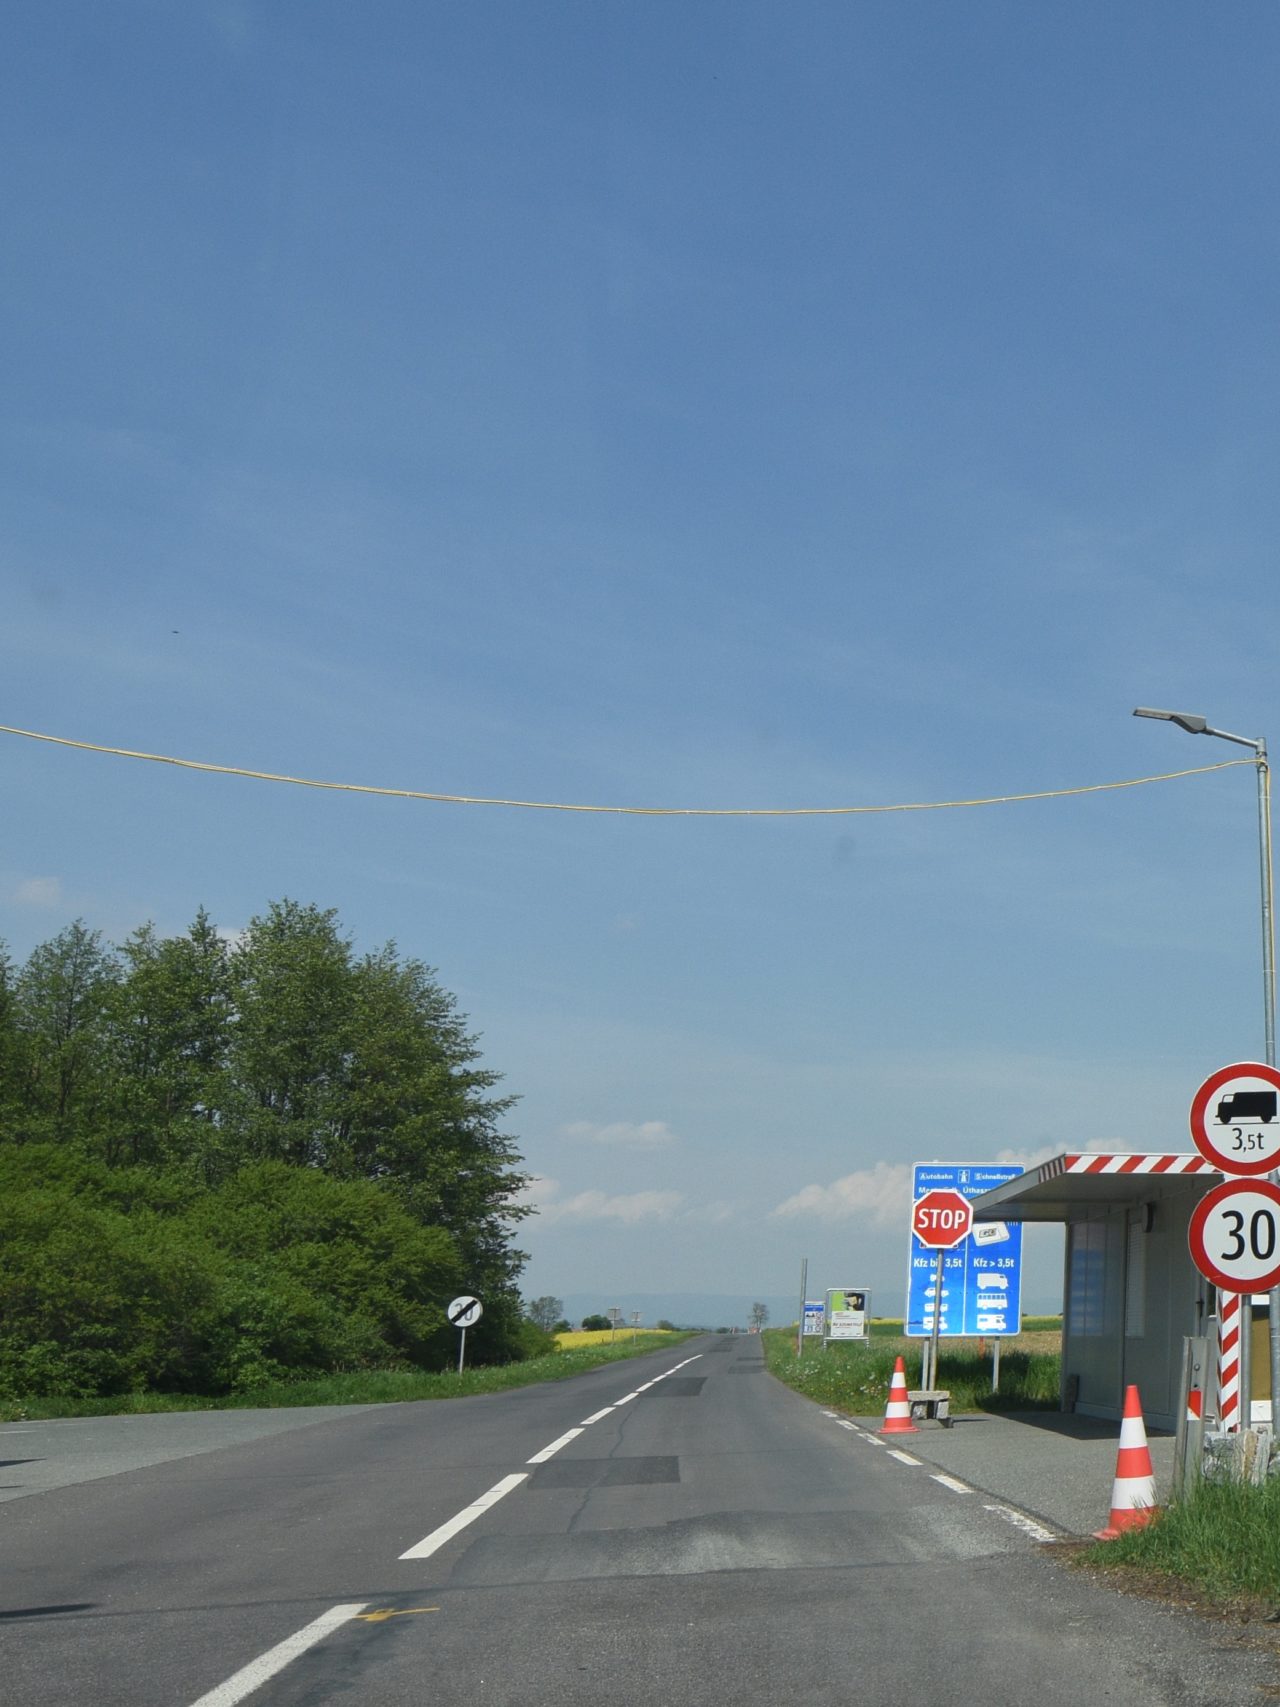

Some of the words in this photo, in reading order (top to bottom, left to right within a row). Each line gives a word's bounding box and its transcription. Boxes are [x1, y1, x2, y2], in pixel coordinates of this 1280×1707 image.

[1232, 1127, 1264, 1152] 3,5t
[917, 1208, 966, 1229] STOP
[1221, 1209, 1276, 1260] 30
[913, 1258, 928, 1268] Kfz
[930, 1258, 940, 1268] bi
[945, 1258, 962, 1269] 3,5t
[973, 1258, 988, 1268] Kfz
[997, 1258, 1014, 1269] 3,5t
